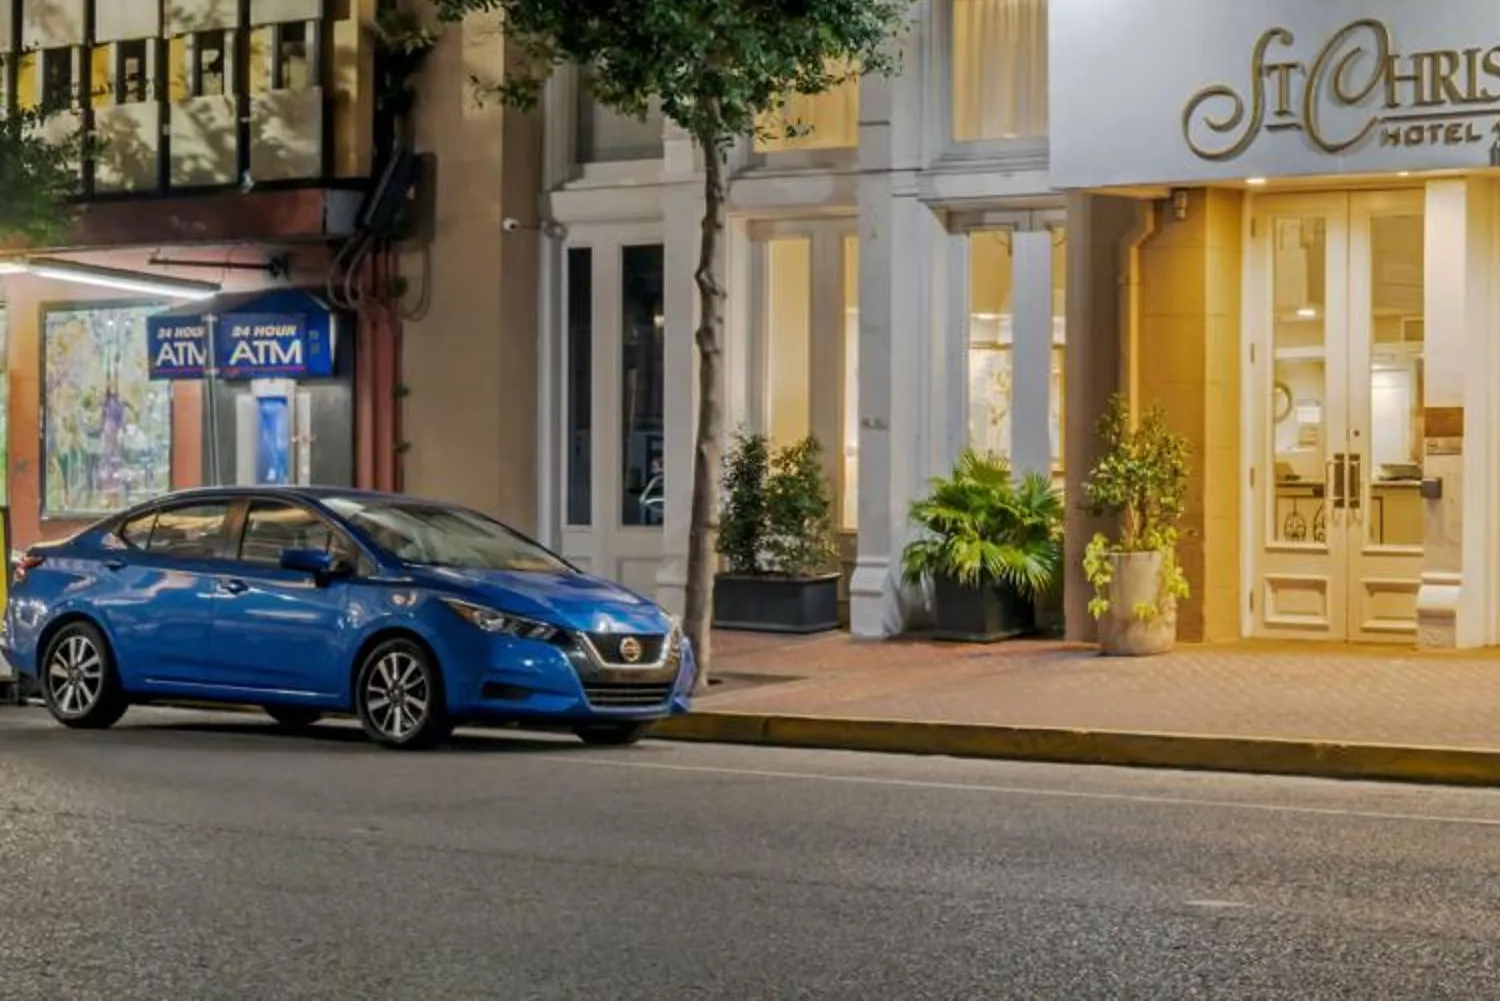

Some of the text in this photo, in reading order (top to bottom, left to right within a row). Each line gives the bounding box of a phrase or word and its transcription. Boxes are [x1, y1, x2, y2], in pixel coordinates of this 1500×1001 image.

[1380, 122, 1482, 147] HOTEL
[174, 325, 206, 339] HOU
[231, 324, 298, 339] 24 HOUR
[228, 339, 304, 366] ATM
